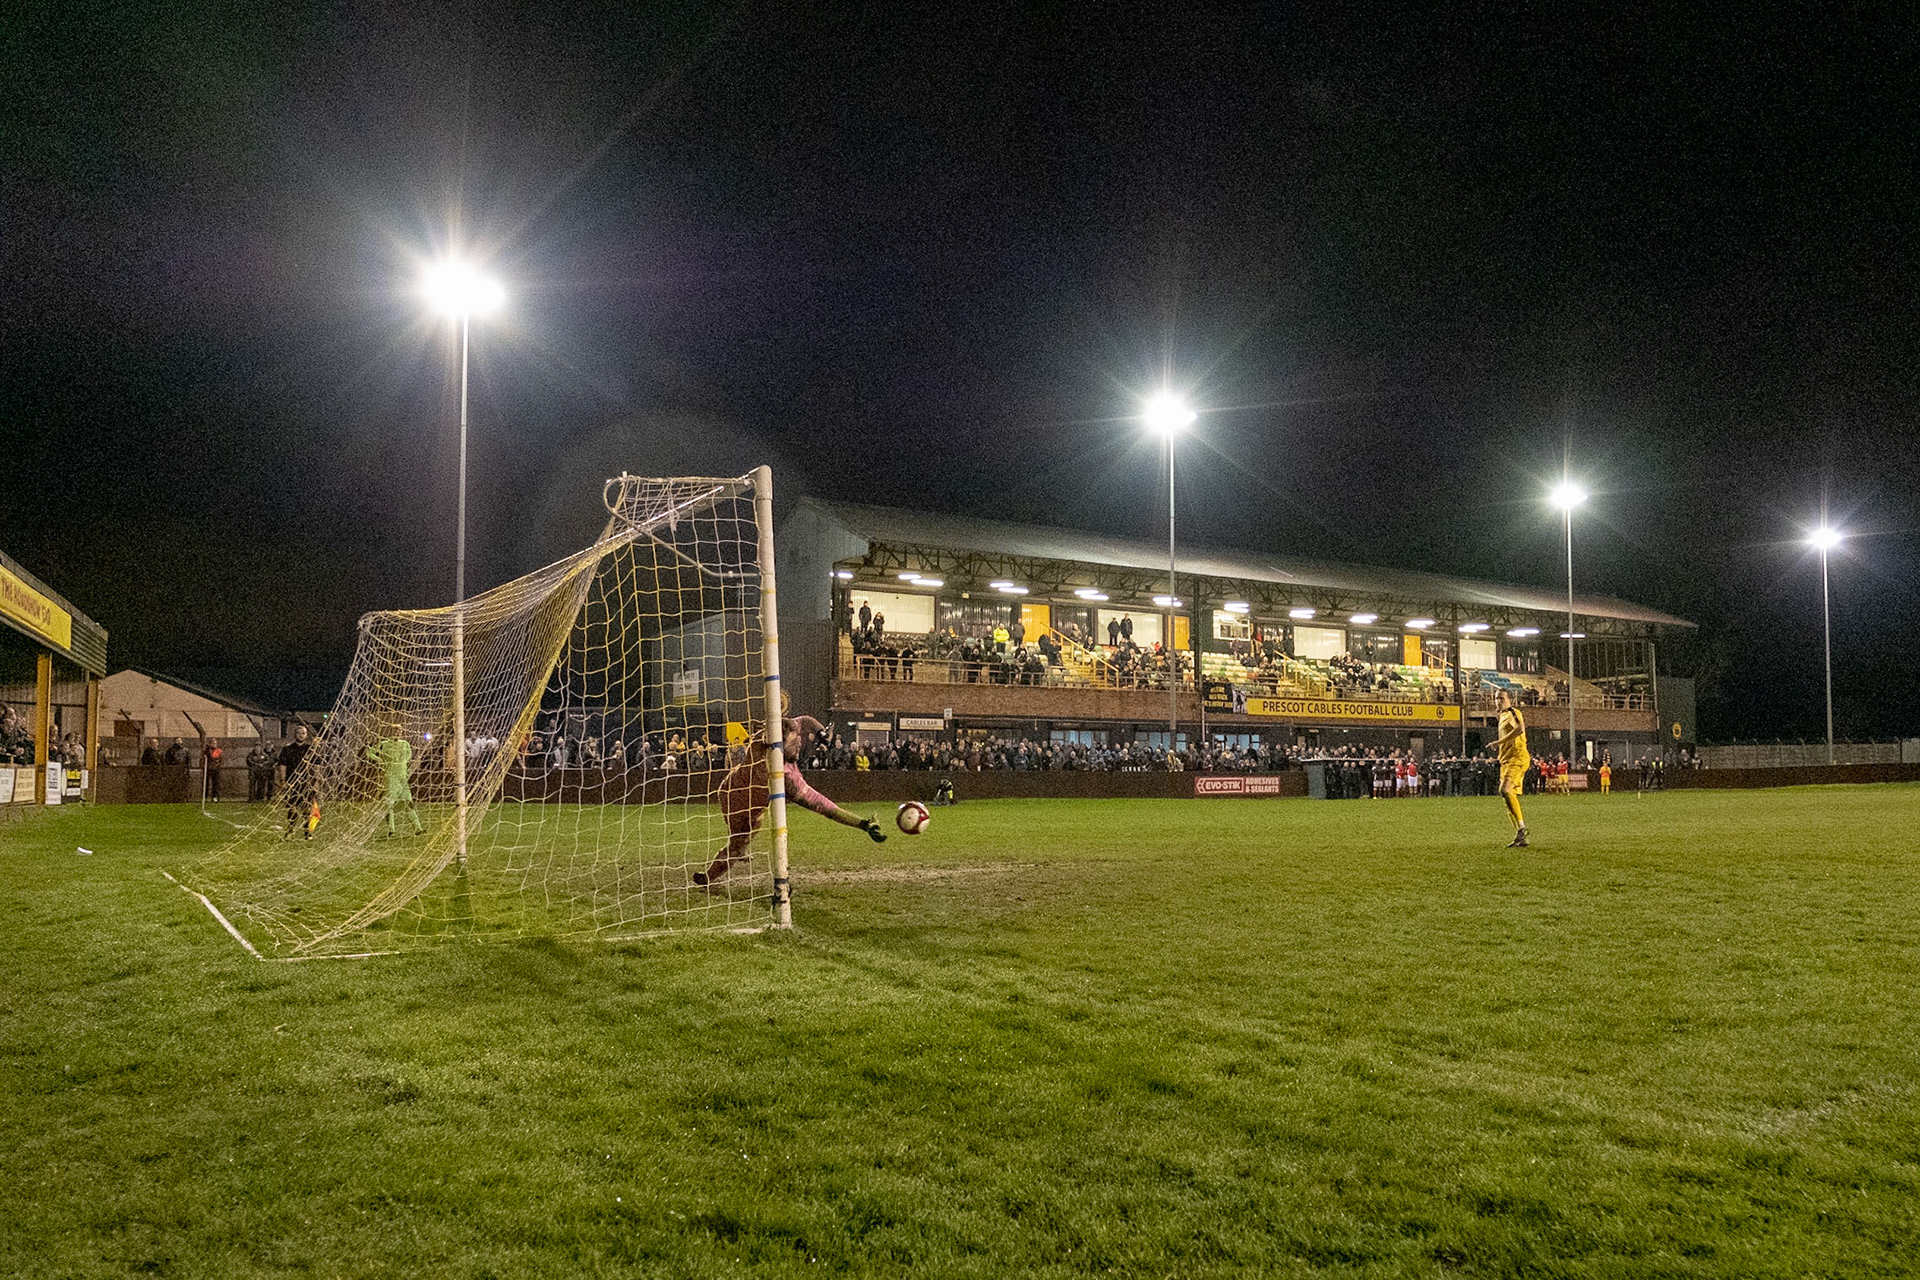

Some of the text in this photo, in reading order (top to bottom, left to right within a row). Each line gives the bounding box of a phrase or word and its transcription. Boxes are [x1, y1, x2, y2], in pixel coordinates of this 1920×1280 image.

[1262, 701, 1414, 717] PRESCOT CABLES FOOTBALL CLUB
[1245, 777, 1280, 785] ADHESIVES
[1251, 785, 1280, 793] SEALANTS
